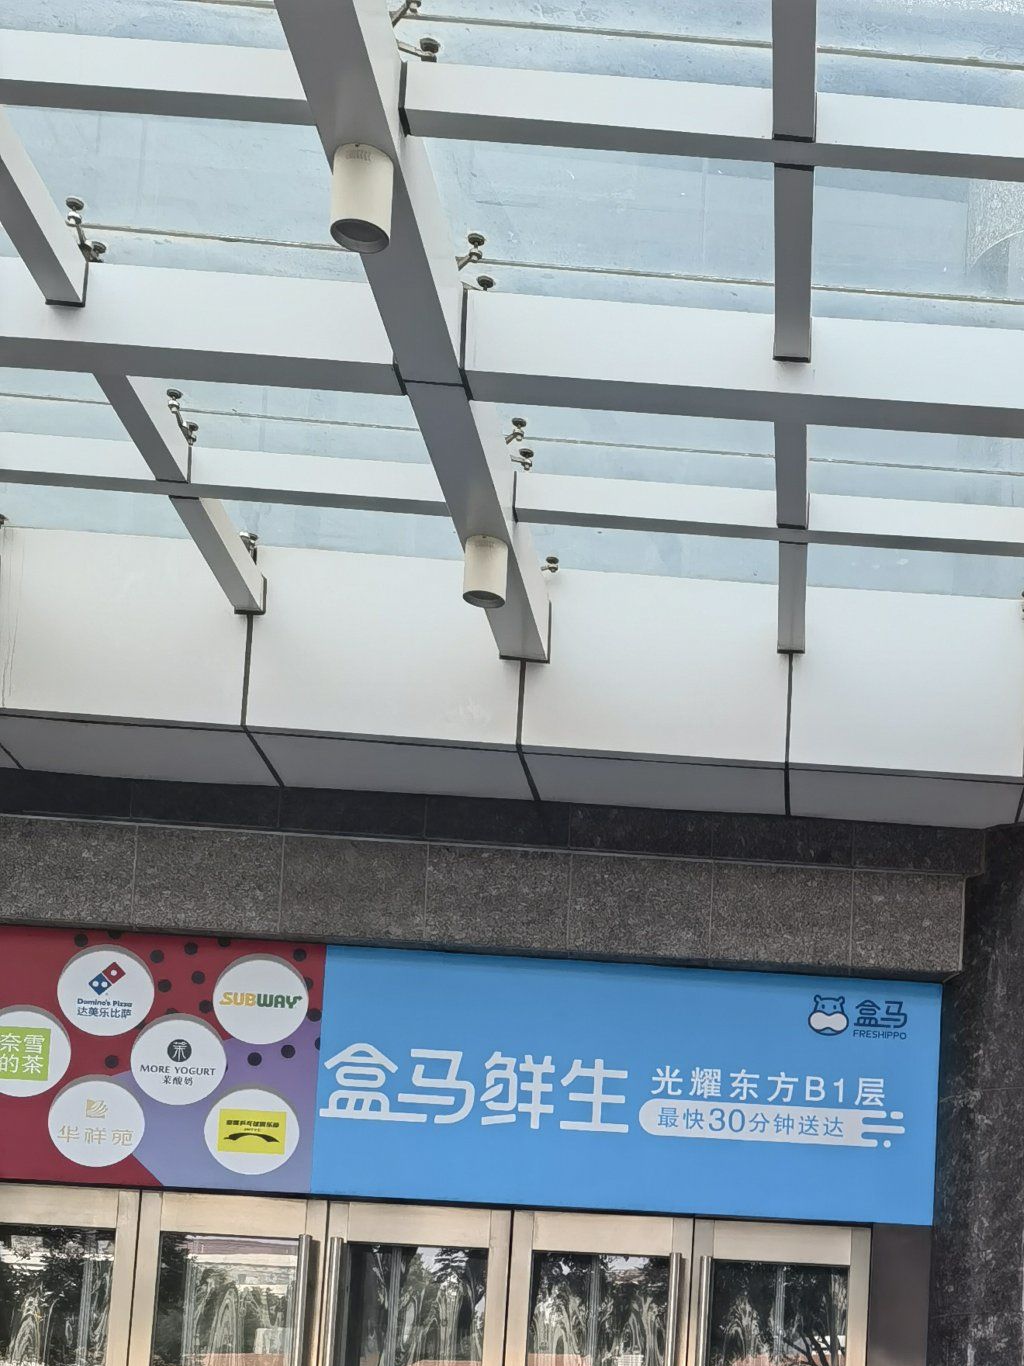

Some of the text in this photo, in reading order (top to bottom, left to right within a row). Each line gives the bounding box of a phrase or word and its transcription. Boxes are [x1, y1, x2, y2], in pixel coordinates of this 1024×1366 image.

[77, 998, 133, 1008] Domino's Pizza
[219, 991, 303, 1009] SUBWAY
[77, 1007, 132, 1018] 达美乐比萨
[853, 999, 908, 1028] 盒马
[0, 1033, 46, 1054] 奈雪
[852, 1029, 907, 1040] FRESHIPPO
[0, 1053, 44, 1074] 的茶
[140, 1064, 217, 1076] MORE YOGURT
[319, 1042, 629, 1133] 盒马鲜生
[651, 1065, 885, 1107] 光耀东方B1层
[657, 1106, 845, 1138] 最快30分钟送达
[57, 1125, 134, 1147] 华祥苑
